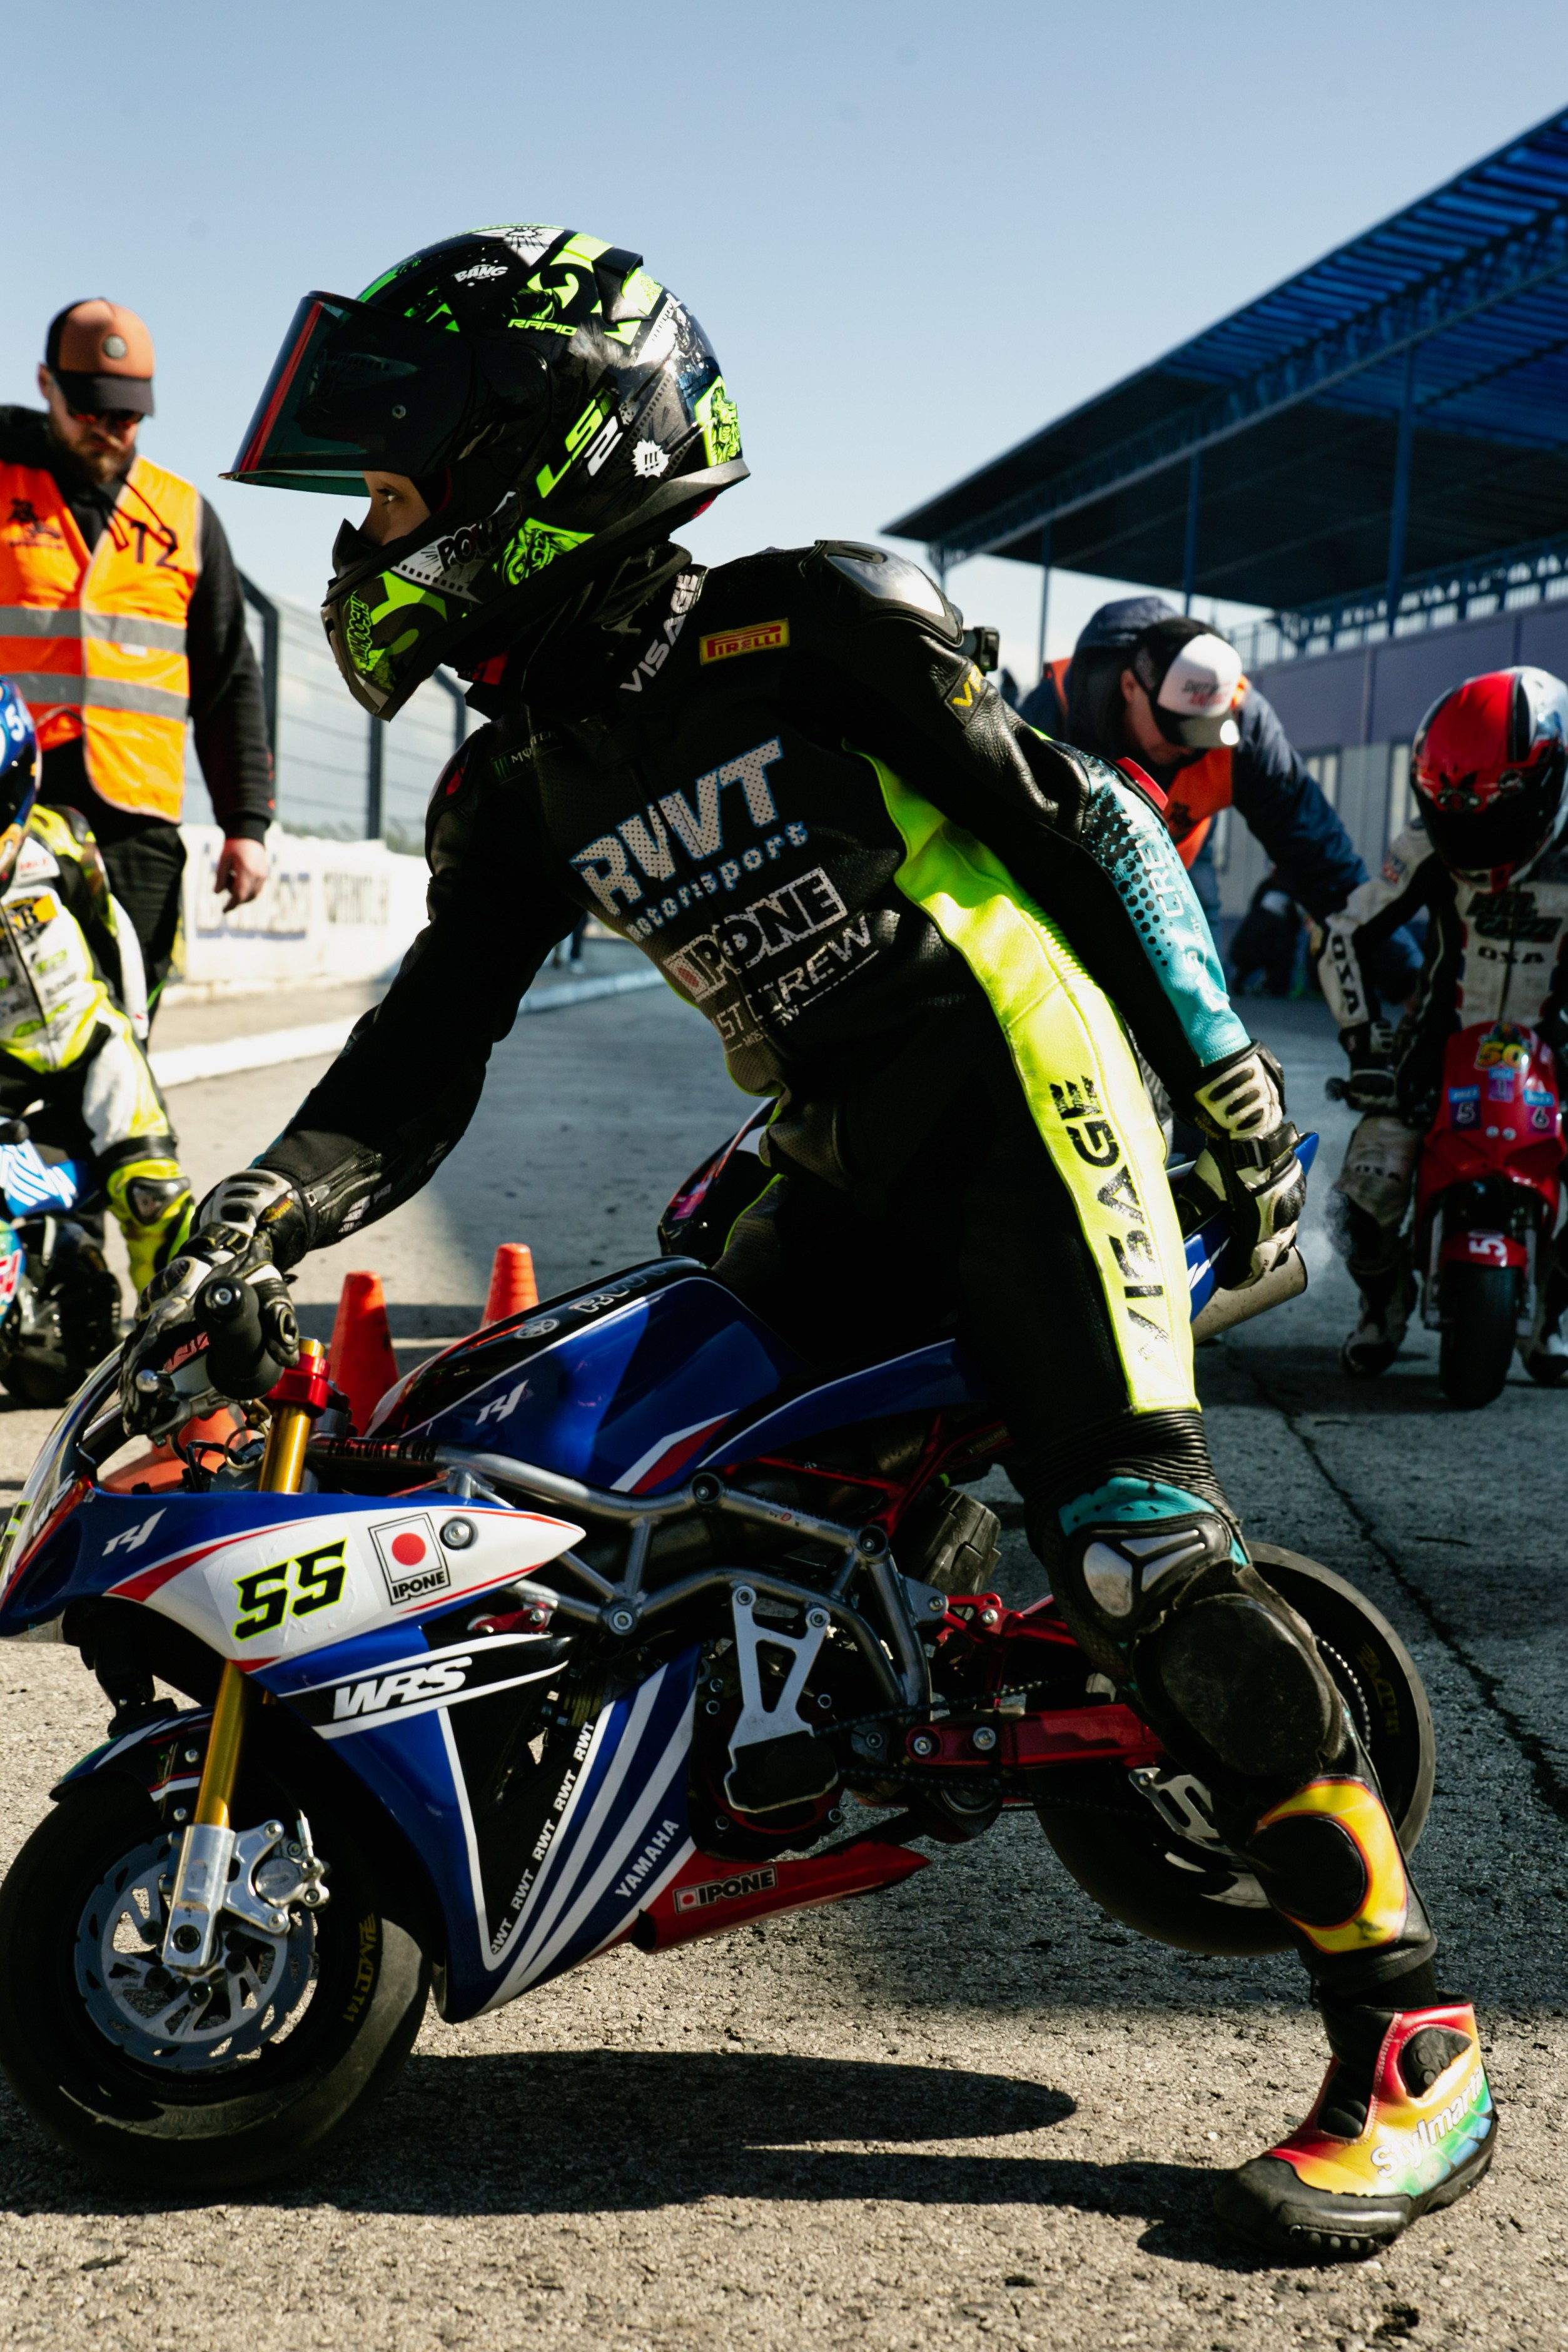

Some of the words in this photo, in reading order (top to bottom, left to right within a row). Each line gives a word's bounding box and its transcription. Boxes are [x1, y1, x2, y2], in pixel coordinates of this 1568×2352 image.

[454, 263, 508, 283] BANG
[507, 318, 579, 337] RAPID
[535, 398, 624, 499] LS2
[619, 572, 702, 693] VISAGE
[707, 625, 783, 659] PIRELLI
[568, 734, 786, 918] RWT
[1475, 1041, 1532, 1069] 50
[1455, 1100, 1477, 1125] 5
[1530, 1105, 1551, 1130] 6
[1049, 1075, 1171, 1361] VISAGE
[231, 1536, 348, 1643] 55
[392, 1570, 447, 1605] IPONE
[333, 1656, 473, 1721] WRS
[511, 1868, 534, 1912] RWT
[532, 1818, 556, 1862] RWT
[554, 1770, 577, 1813] RWT
[573, 1721, 595, 1763] RWT
[614, 1818, 680, 1899] YAMAHA
[698, 1867, 776, 1905] IPONE
